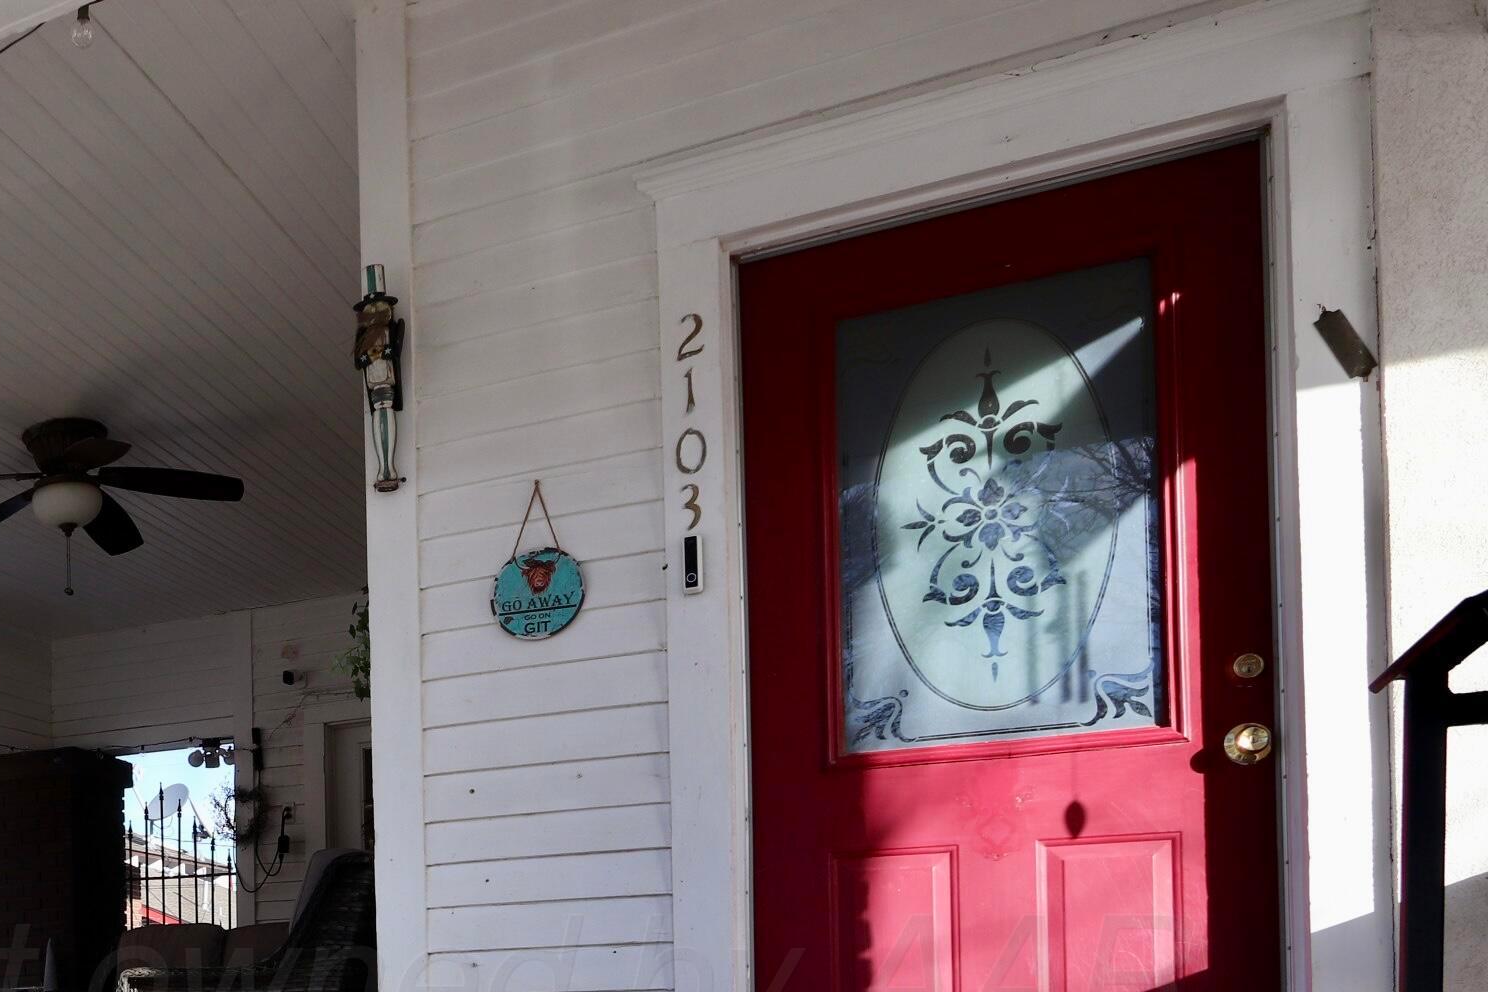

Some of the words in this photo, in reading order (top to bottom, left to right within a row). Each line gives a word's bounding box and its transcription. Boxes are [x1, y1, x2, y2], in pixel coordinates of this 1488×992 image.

[676, 313, 707, 530] 2103
[501, 600, 522, 612] GO
[527, 591, 575, 609] AWAY
[524, 620, 551, 634] GIT
